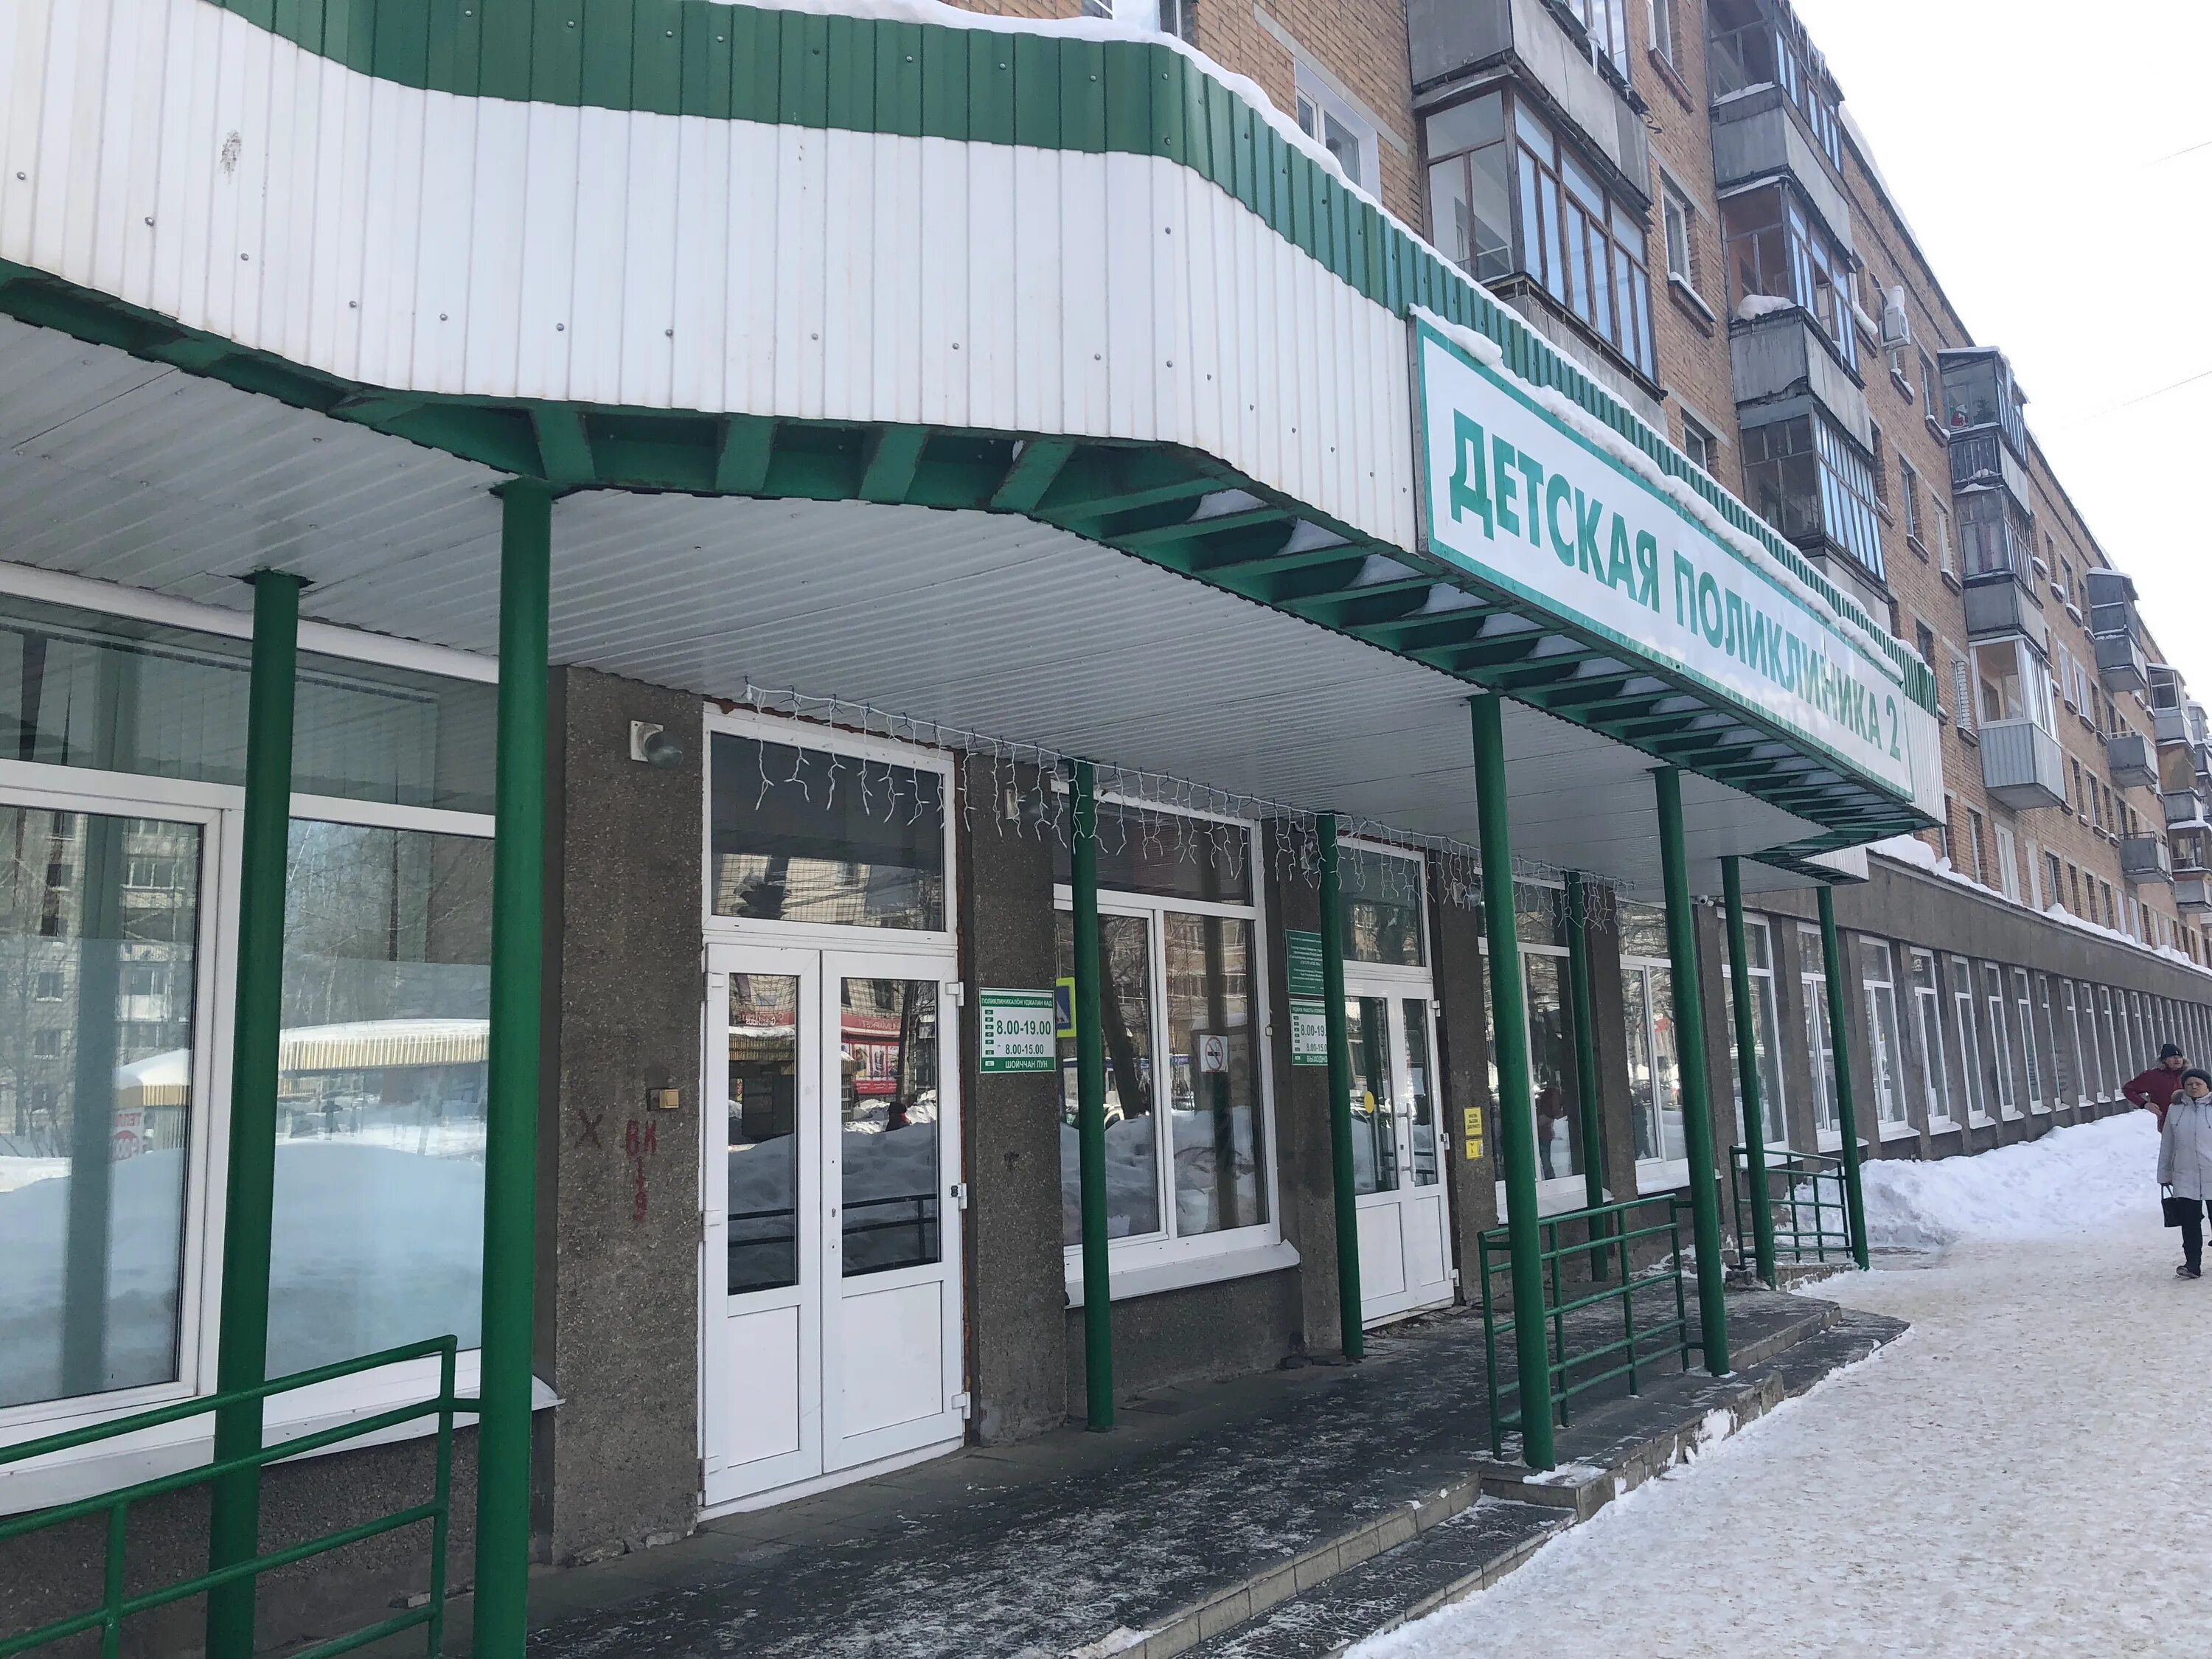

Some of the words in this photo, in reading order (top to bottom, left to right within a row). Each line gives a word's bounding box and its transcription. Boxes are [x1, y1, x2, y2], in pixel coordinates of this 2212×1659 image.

[1450, 408, 1660, 613] ДЕТСКАЯ
[1674, 550, 1882, 750] ПОЛИКЛИНИКА
[1886, 695, 1902, 762] 2
[996, 1020, 1051, 1035] 8.00-19.00
[1301, 1024, 1326, 1037] 8.00-19.
[1005, 1043, 1044, 1054] 8.00-15.00
[1307, 1043, 1327, 1051] 8.00-15.0
[1005, 1060, 1035, 1068] ШОЙЧЧАН
[1036, 1060, 1048, 1068] ЛУН
